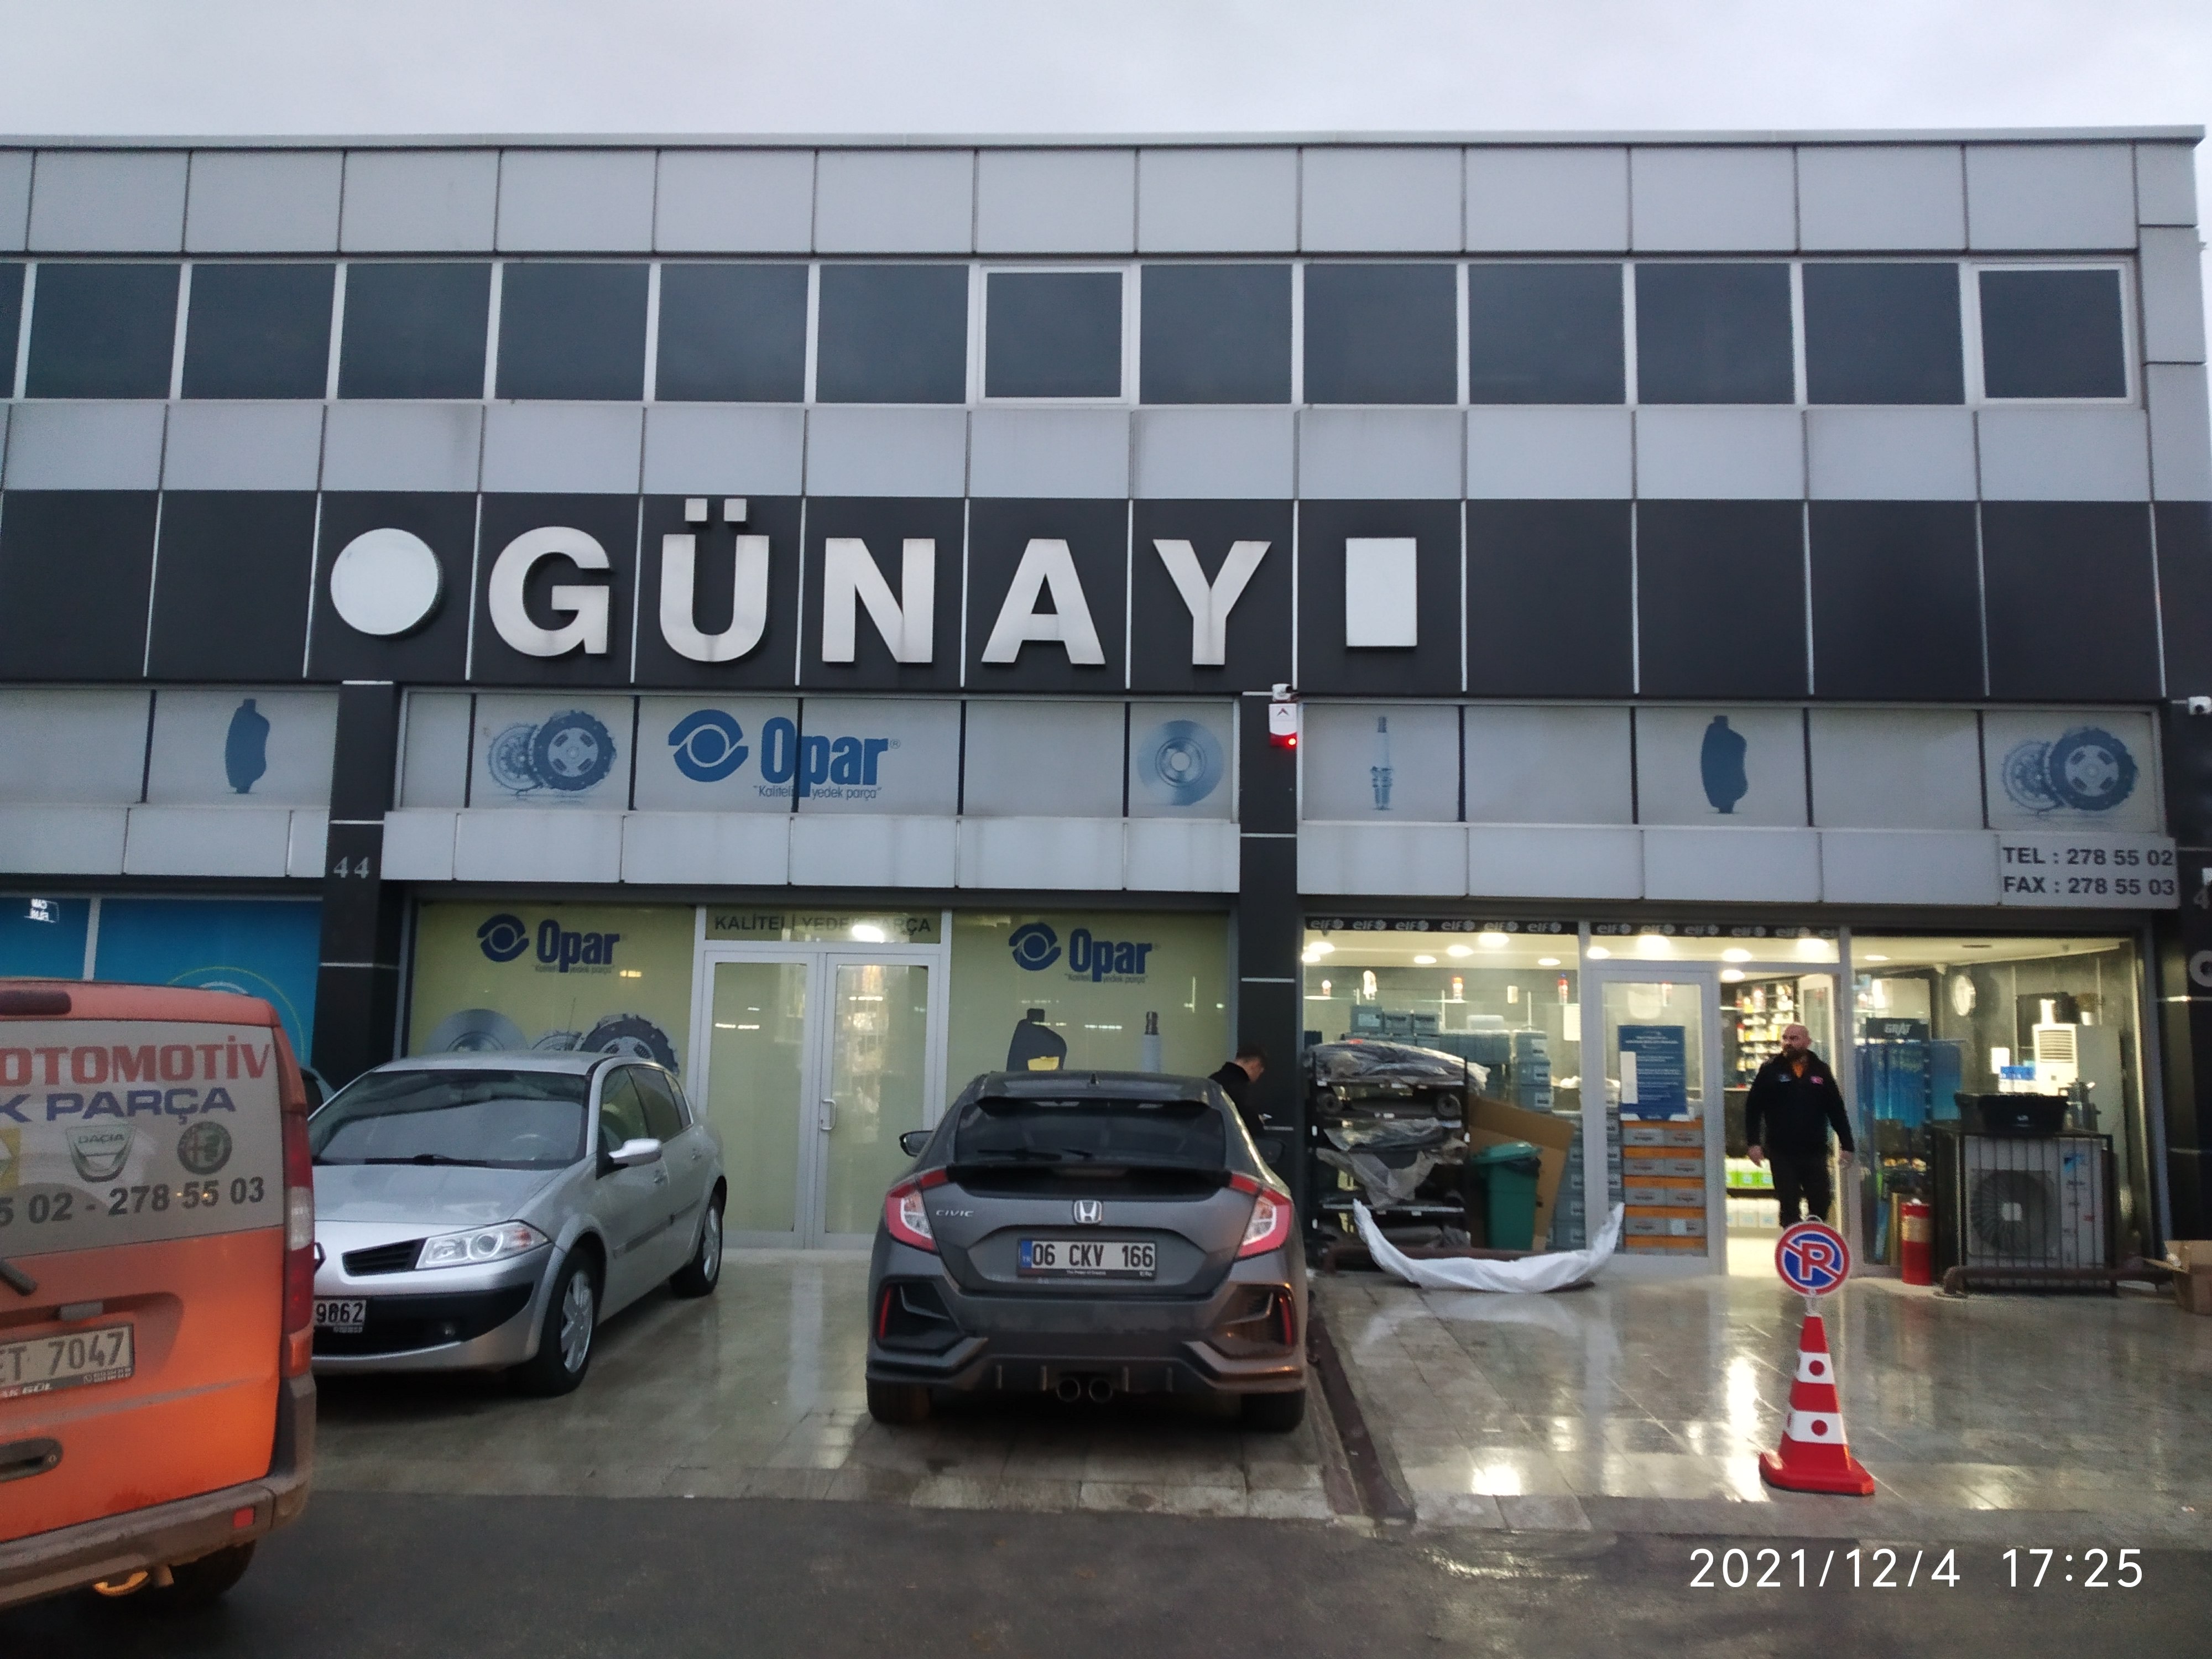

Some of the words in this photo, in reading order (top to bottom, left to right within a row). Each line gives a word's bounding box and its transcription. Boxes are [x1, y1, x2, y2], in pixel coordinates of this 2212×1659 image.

[488, 498, 1271, 667] GÜNAY
[760, 716, 889, 797] Opar
[333, 857, 370, 879] 44
[2002, 847, 2046, 864] TEL
[2067, 848, 2106, 865] 278
[2114, 849, 2140, 866] 55
[2146, 849, 2173, 867] 02
[2004, 876, 2047, 894] FAX
[2068, 878, 2108, 894] 278
[2115, 879, 2141, 895] 55
[2148, 879, 2175, 896] 03
[537, 919, 620, 973] Opar
[1070, 928, 1152, 982] Opar
[0, 1035, 270, 1087] OTOMOTİV
[46, 1087, 237, 1126] PARÇA
[29, 1192, 73, 1224] 02
[108, 1183, 170, 1216] 278
[182, 1180, 219, 1209] 55
[230, 1176, 264, 1204] 03
[1032, 1244, 1055, 1266] 06
[1069, 1244, 1104, 1267] CKV
[1122, 1245, 1154, 1267] 166
[48, 1331, 124, 1376] 7047
